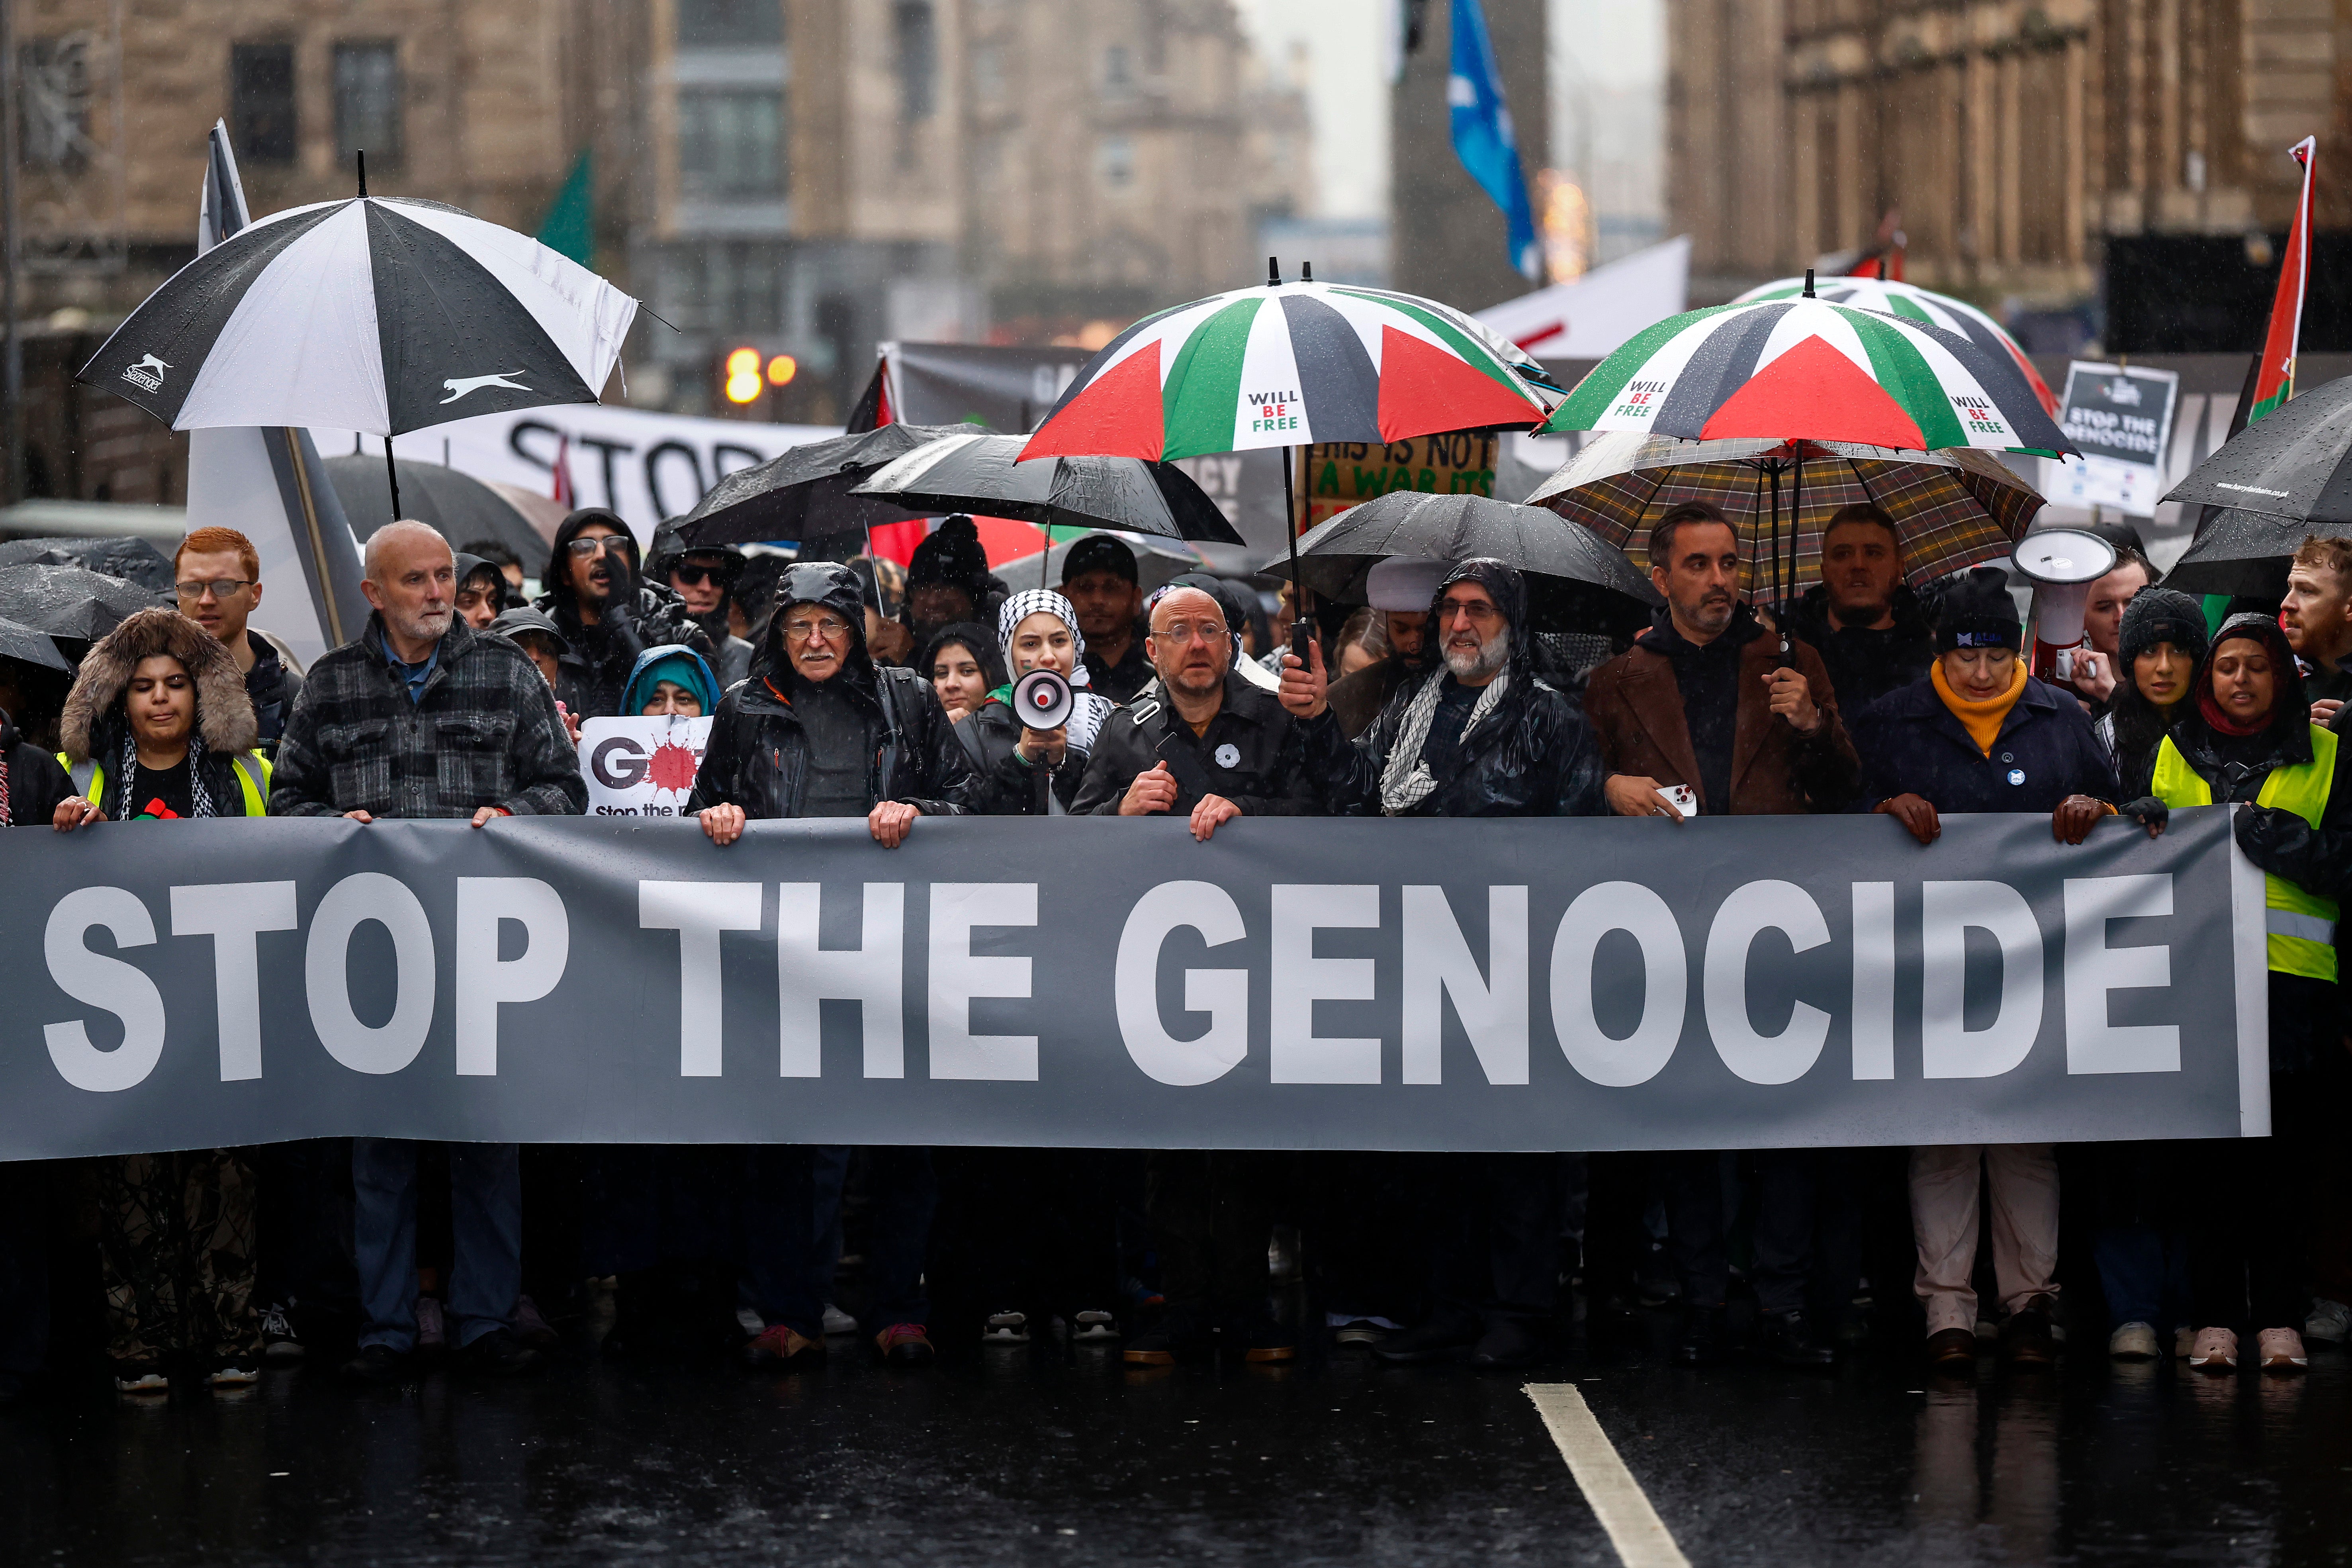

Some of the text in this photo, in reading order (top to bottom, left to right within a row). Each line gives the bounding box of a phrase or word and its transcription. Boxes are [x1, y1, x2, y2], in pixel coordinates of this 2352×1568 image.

[123, 365, 162, 390] Slazenger
[1630, 381, 1666, 392] WILL
[1248, 390, 1298, 405] WILL
[1630, 393, 1651, 404] BE
[1950, 396, 1990, 408] WILL
[1263, 405, 1285, 417] BE
[1614, 405, 1652, 417] FREE
[1968, 409, 1989, 420] BE
[1253, 417, 1297, 432] FREE
[1968, 421, 2004, 433] FREE
[2071, 406, 2157, 437] STOP THE
[1426, 433, 1498, 470] NOT
[1319, 461, 1339, 494] A
[1354, 466, 1436, 497] WAR
[2217, 482, 2289, 497] www.harryfairbairn.co.uk
[596, 805, 638, 816] Stop
[642, 803, 673, 816] the
[43, 872, 2181, 1092] STOP THE GENOCIDE
